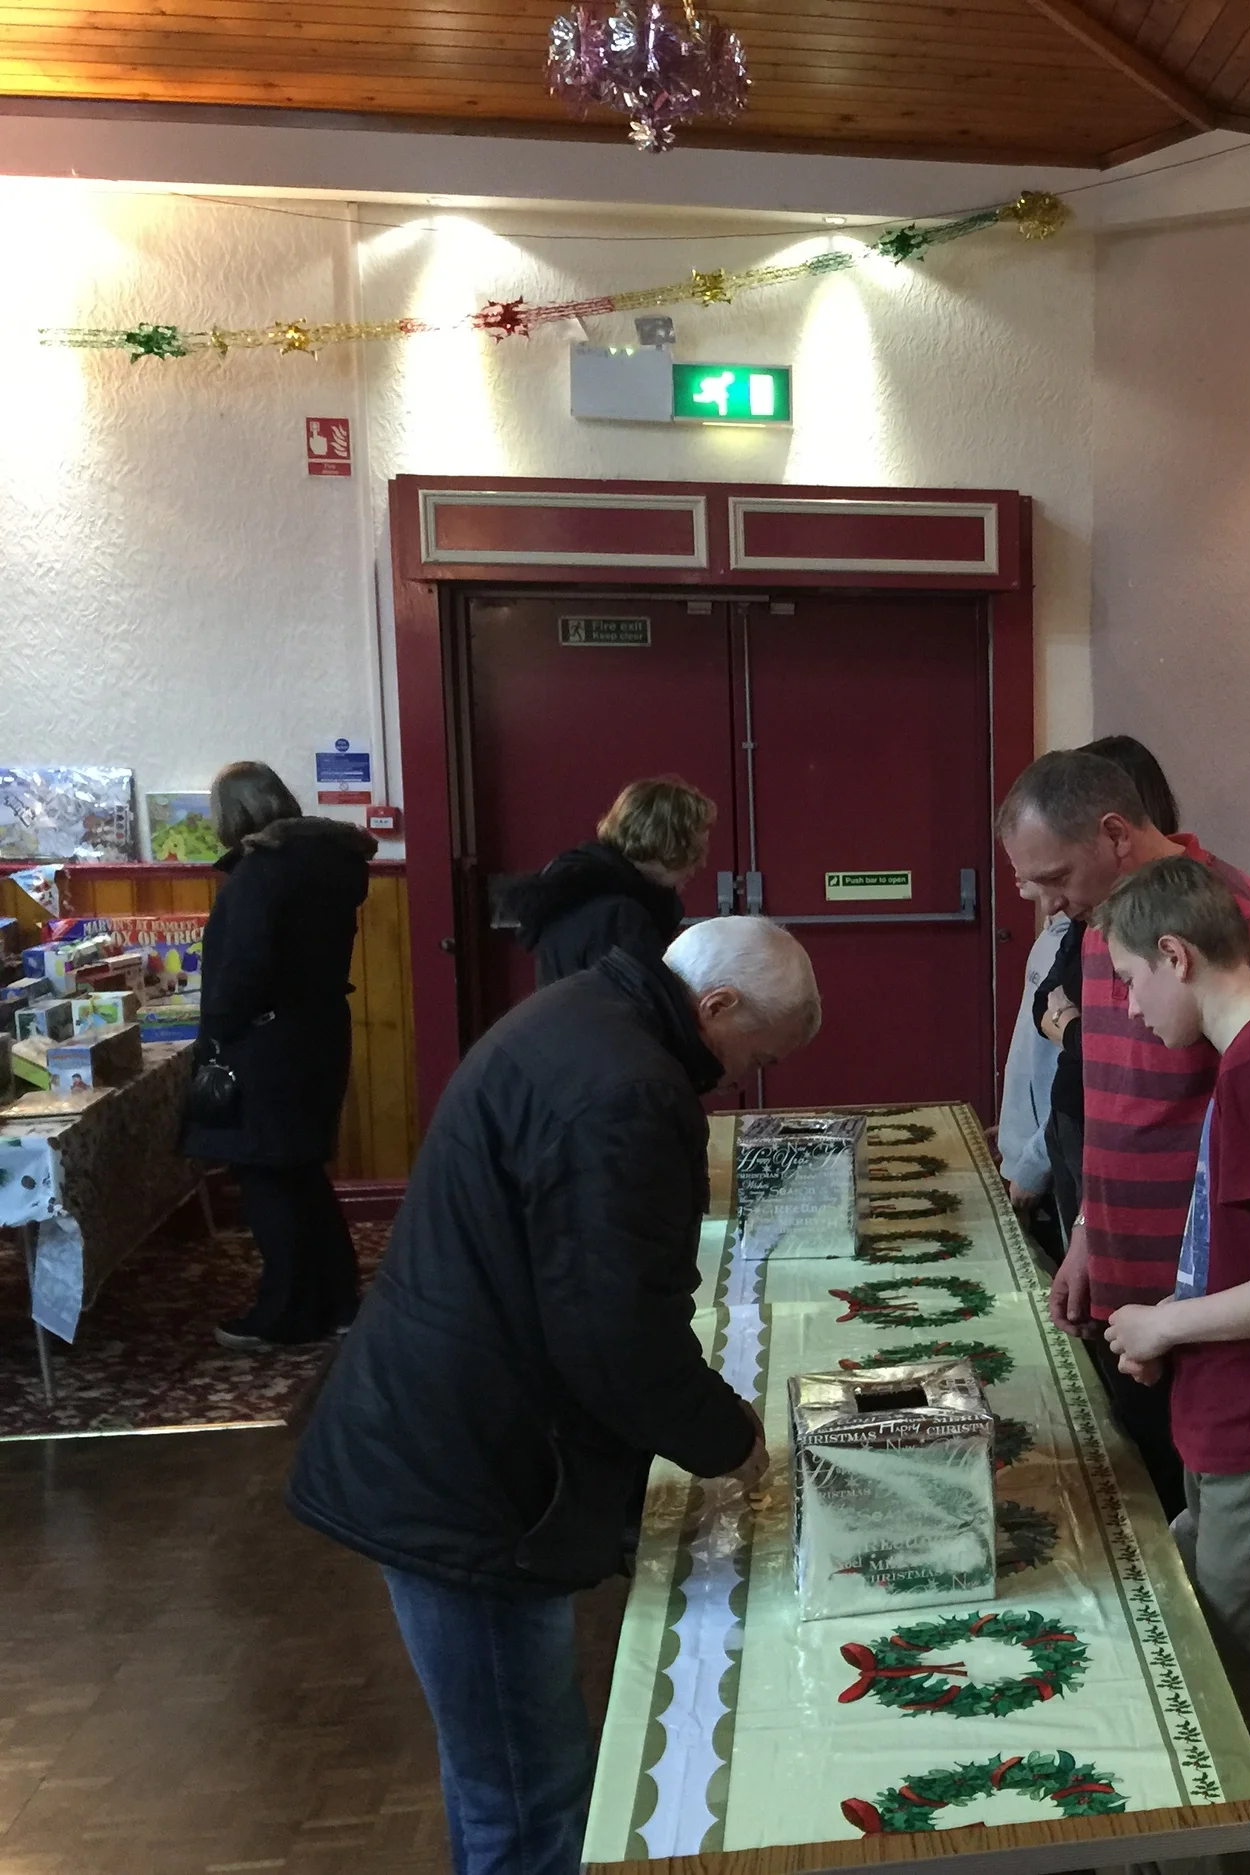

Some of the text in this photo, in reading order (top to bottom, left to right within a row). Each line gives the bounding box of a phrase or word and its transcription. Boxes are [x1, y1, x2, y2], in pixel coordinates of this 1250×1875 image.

[592, 620, 643, 631] Fire exit
[865, 876, 877, 884] bar
[888, 877, 906, 885] open
[110, 927, 204, 947] OX OF TRIC
[926, 1422, 991, 1436] CHRISTM
[870, 1569, 942, 1583] HRISTMAS
